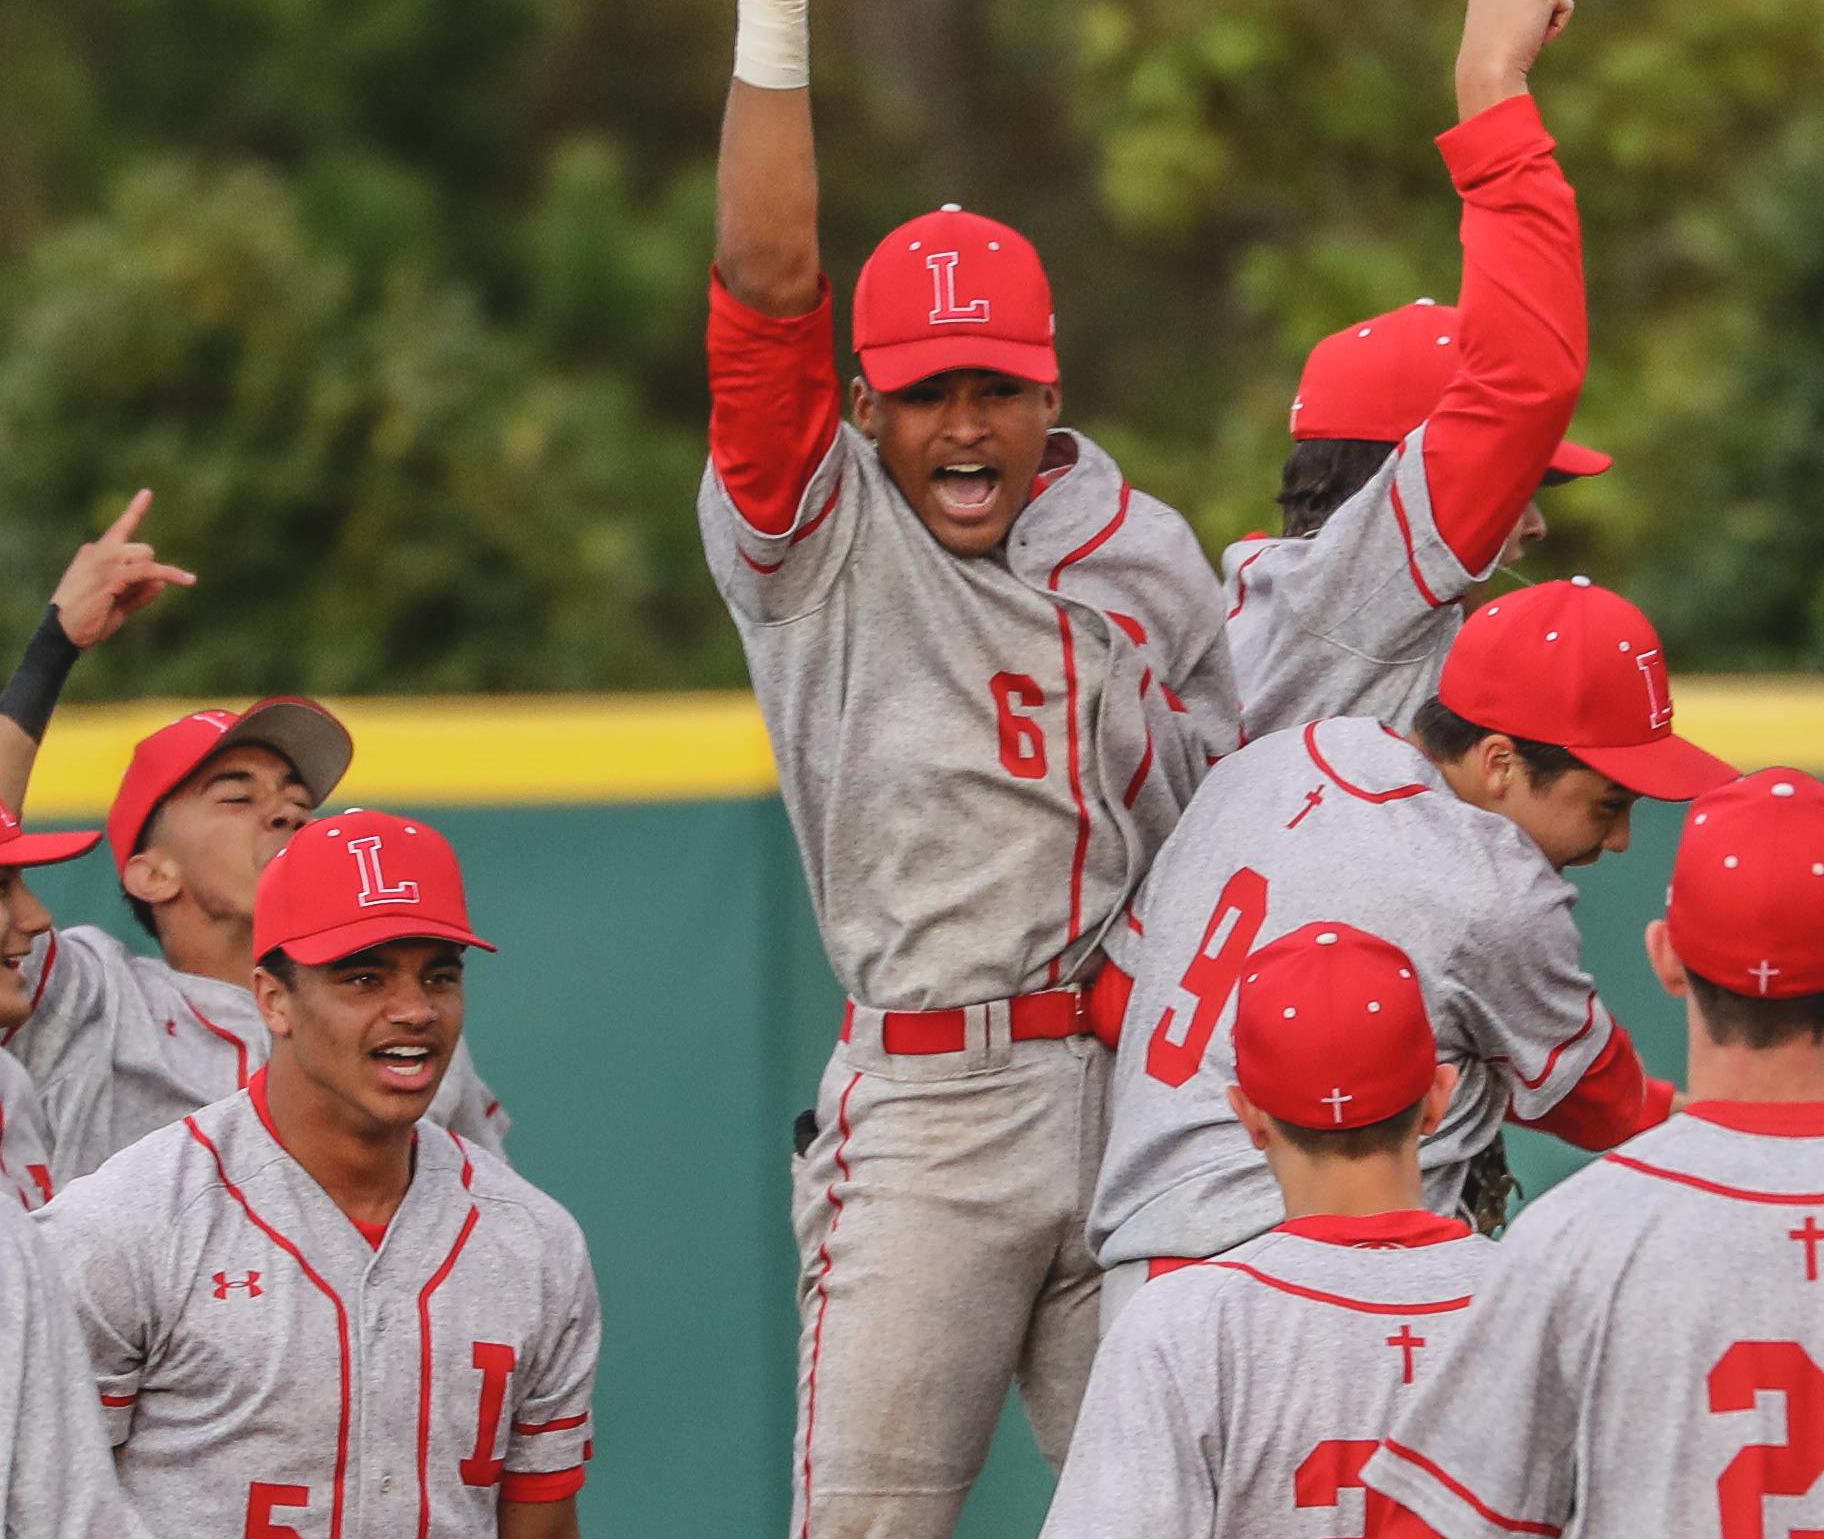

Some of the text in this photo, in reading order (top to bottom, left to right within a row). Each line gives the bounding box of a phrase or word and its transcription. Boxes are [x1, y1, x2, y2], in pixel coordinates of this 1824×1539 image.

[926, 251, 990, 324] L
[990, 671, 1048, 779] 6
[347, 835, 419, 907] L
[1145, 866, 1268, 1088] 9
